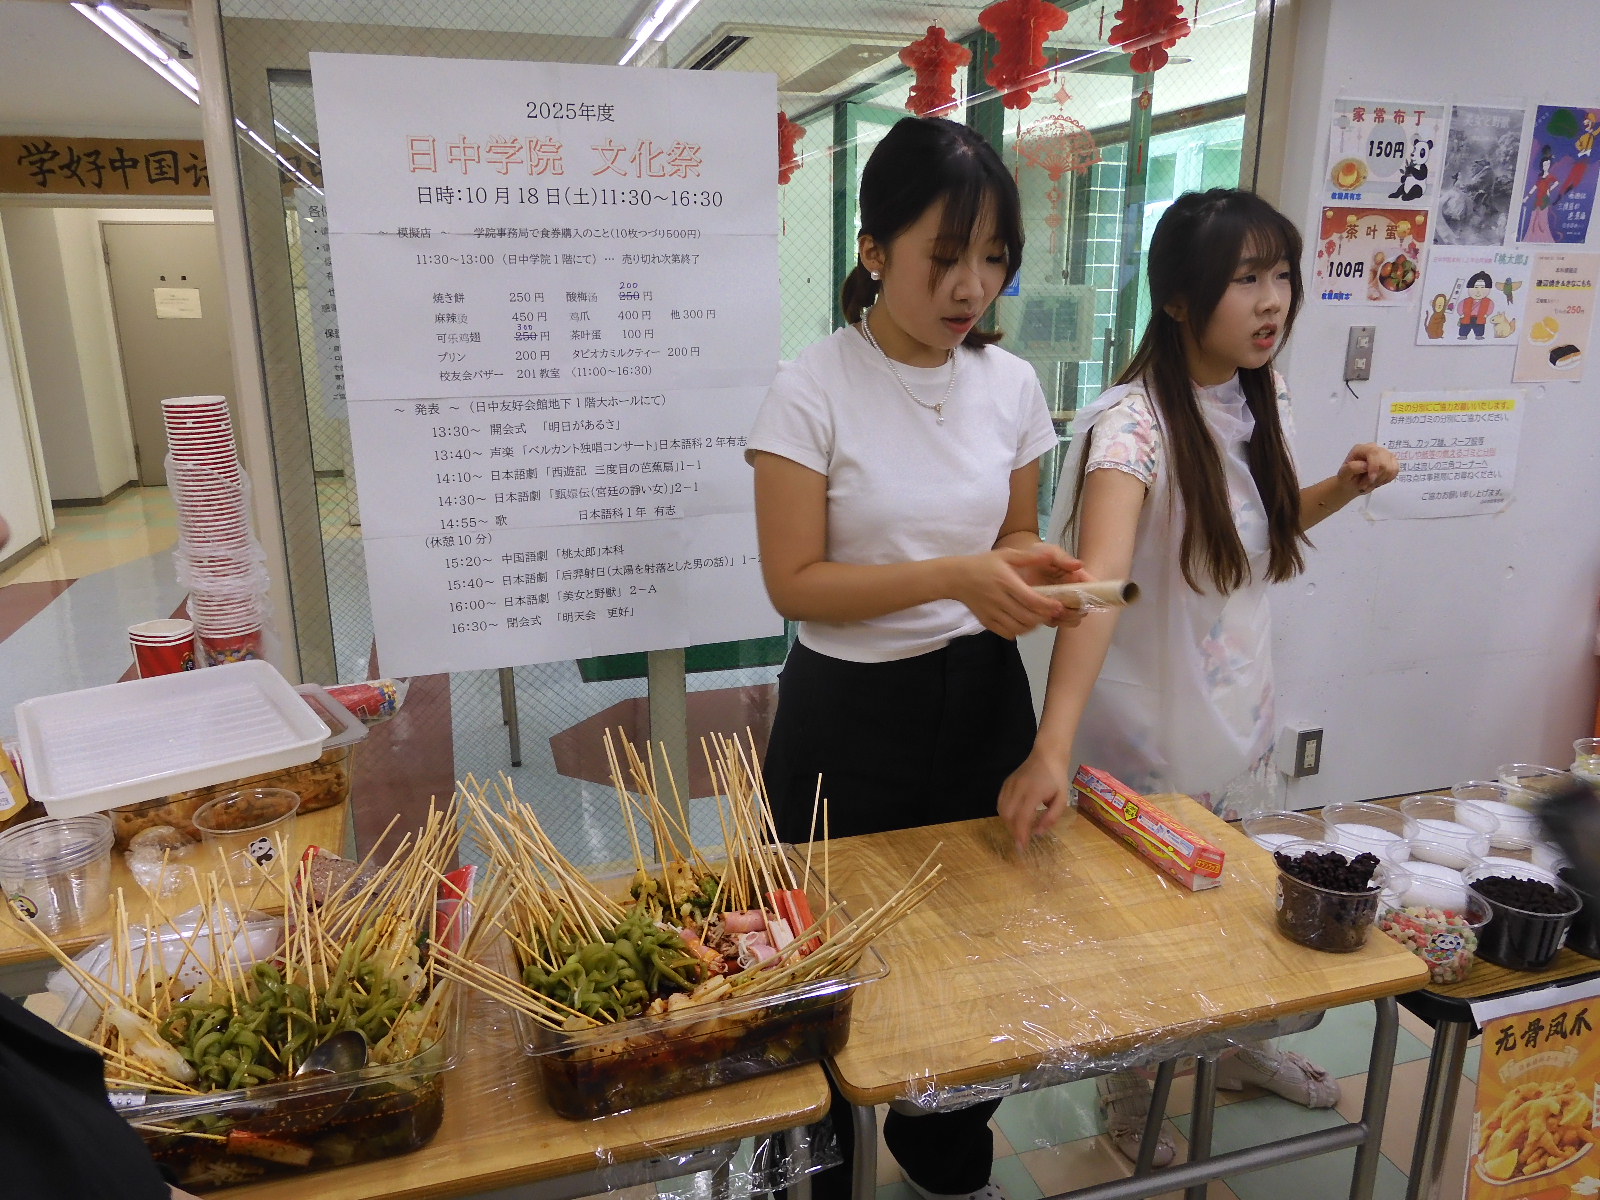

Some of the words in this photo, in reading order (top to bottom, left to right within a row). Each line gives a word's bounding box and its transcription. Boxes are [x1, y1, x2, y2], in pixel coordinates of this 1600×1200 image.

[526, 101, 615, 122] 2025年度
[1353, 107, 1425, 126] 家常布丁
[405, 135, 564, 176] 日中学院
[590, 137, 704, 178] 文化祭
[1369, 140, 1404, 158] 150円
[1345, 223, 1399, 240] 茶叶蛋
[622, 253, 700, 265] 売り切れ次第終了
[1328, 261, 1364, 278] 100円
[619, 281, 638, 290] 200
[432, 292, 465, 304] 焼き餅
[509, 292, 545, 303] 250円
[511, 312, 547, 322] 450円
[617, 310, 652, 321] 400円
[571, 330, 602, 341] 茶叶蛋
[622, 329, 654, 339] 100円
[438, 351, 466, 363] プリン
[515, 350, 550, 361] 200円
[572, 348, 661, 359] タピオカミルクティー
[667, 346, 700, 357] 200円
[439, 370, 504, 382] 校友会バザー
[517, 367, 561, 379] 201教室
[490, 422, 527, 436] 開会式
[543, 419, 620, 433] 「明日があるさ」
[490, 446, 514, 459] 声楽
[491, 467, 538, 482] 日本語劇
[494, 490, 541, 504] 日本語劇
[495, 514, 508, 527] 歌
[654, 504, 676, 518] 有志
[501, 550, 548, 565] 中国語劇
[502, 571, 548, 587] 日本語劇
[504, 593, 549, 608] 日本語劇
[506, 615, 542, 629] 閉会式
[1495, 1008, 1592, 1056] 无骨凤爪
